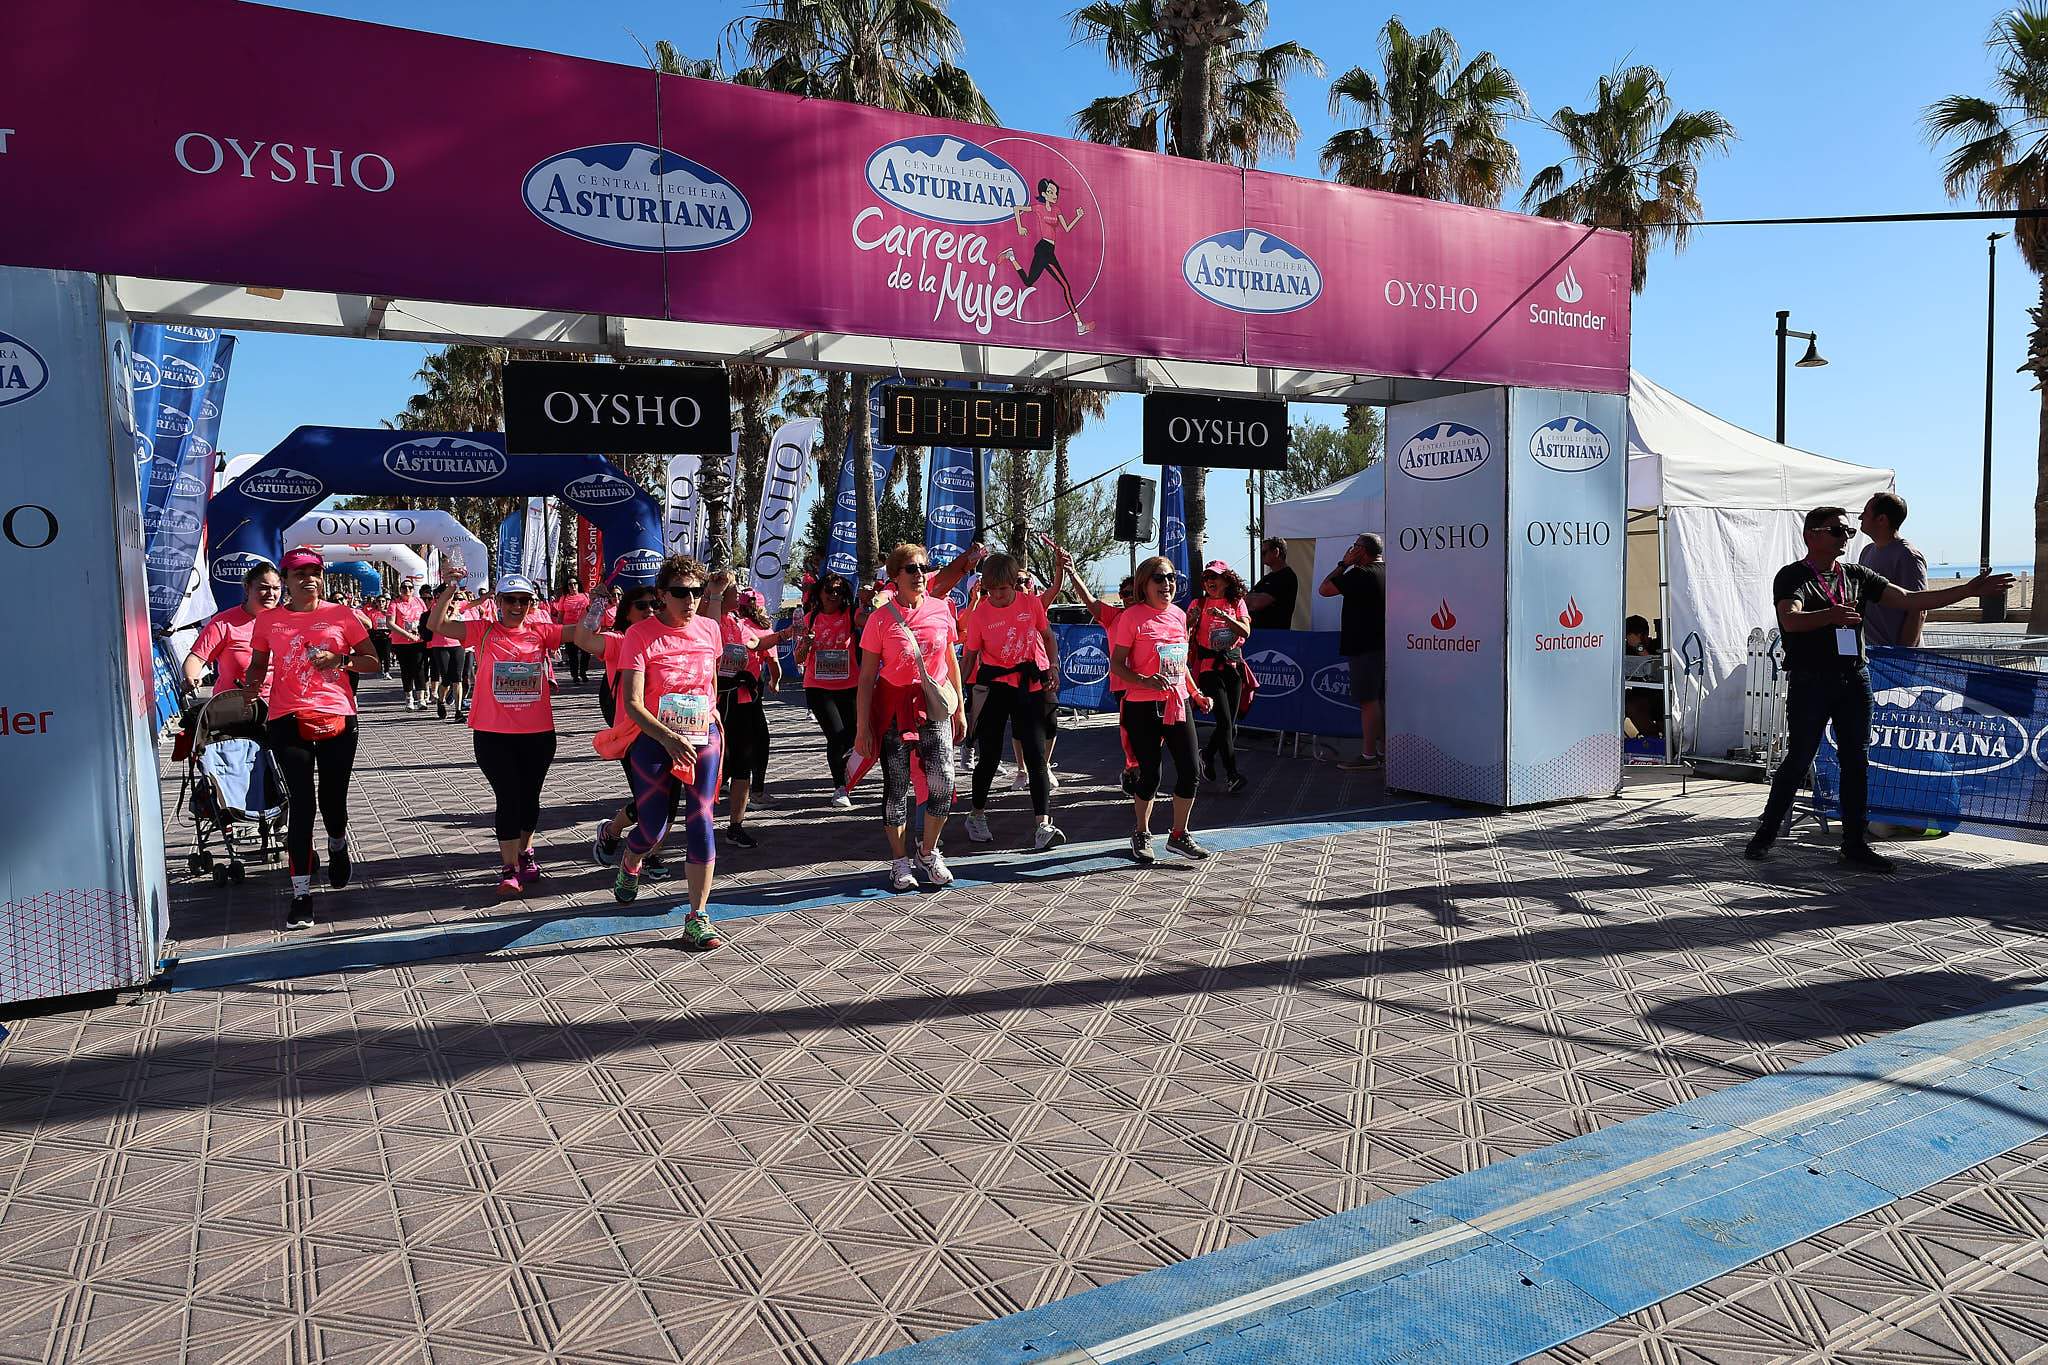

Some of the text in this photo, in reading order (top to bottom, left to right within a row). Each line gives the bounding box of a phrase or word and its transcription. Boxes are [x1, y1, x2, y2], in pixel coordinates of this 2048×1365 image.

[174, 132, 395, 192] OYSHO
[904, 159, 1013, 184] CENTRAL LECHERA
[577, 174, 728, 200] CENTRAL LECHERA
[879, 158, 1017, 208] ASTURIANA
[541, 173, 736, 231] ASTURIANA
[852, 206, 988, 266] Carrera
[1194, 254, 1313, 297] ASTURIANA
[1215, 255, 1308, 272] CENTRAL LECHERA
[887, 259, 1037, 335] de la Mujer
[1384, 279, 1478, 314] OYSHO
[1529, 303, 1607, 331] Santander
[543, 391, 701, 428] OYSHO
[896, 395, 1042, 439] 01:15:47
[1168, 416, 1270, 448] OYSHO
[1417, 437, 1481, 451] CENTRAL LECHERA
[1404, 446, 1484, 470] ASTURIANA
[1535, 435, 1605, 460] ASTURIANA
[393, 449, 499, 473] ASTURIANA
[245, 480, 317, 495] ASTURIANA
[570, 486, 631, 498] ASTURIANA
[669, 476, 694, 545] SHO
[755, 443, 804, 580] OYSHO
[317, 517, 416, 536] OYSHO
[442, 535, 471, 543] OYSHO
[1399, 523, 1489, 552] OYSHO
[1527, 521, 1611, 547] OYSHO
[1407, 633, 1481, 653] Santander
[1535, 631, 1604, 652] Santander
[1066, 658, 1106, 676] ASTURIANA
[1871, 711, 2007, 732] CENTRAL LECHERA
[1869, 724, 2011, 759] STURIANA
